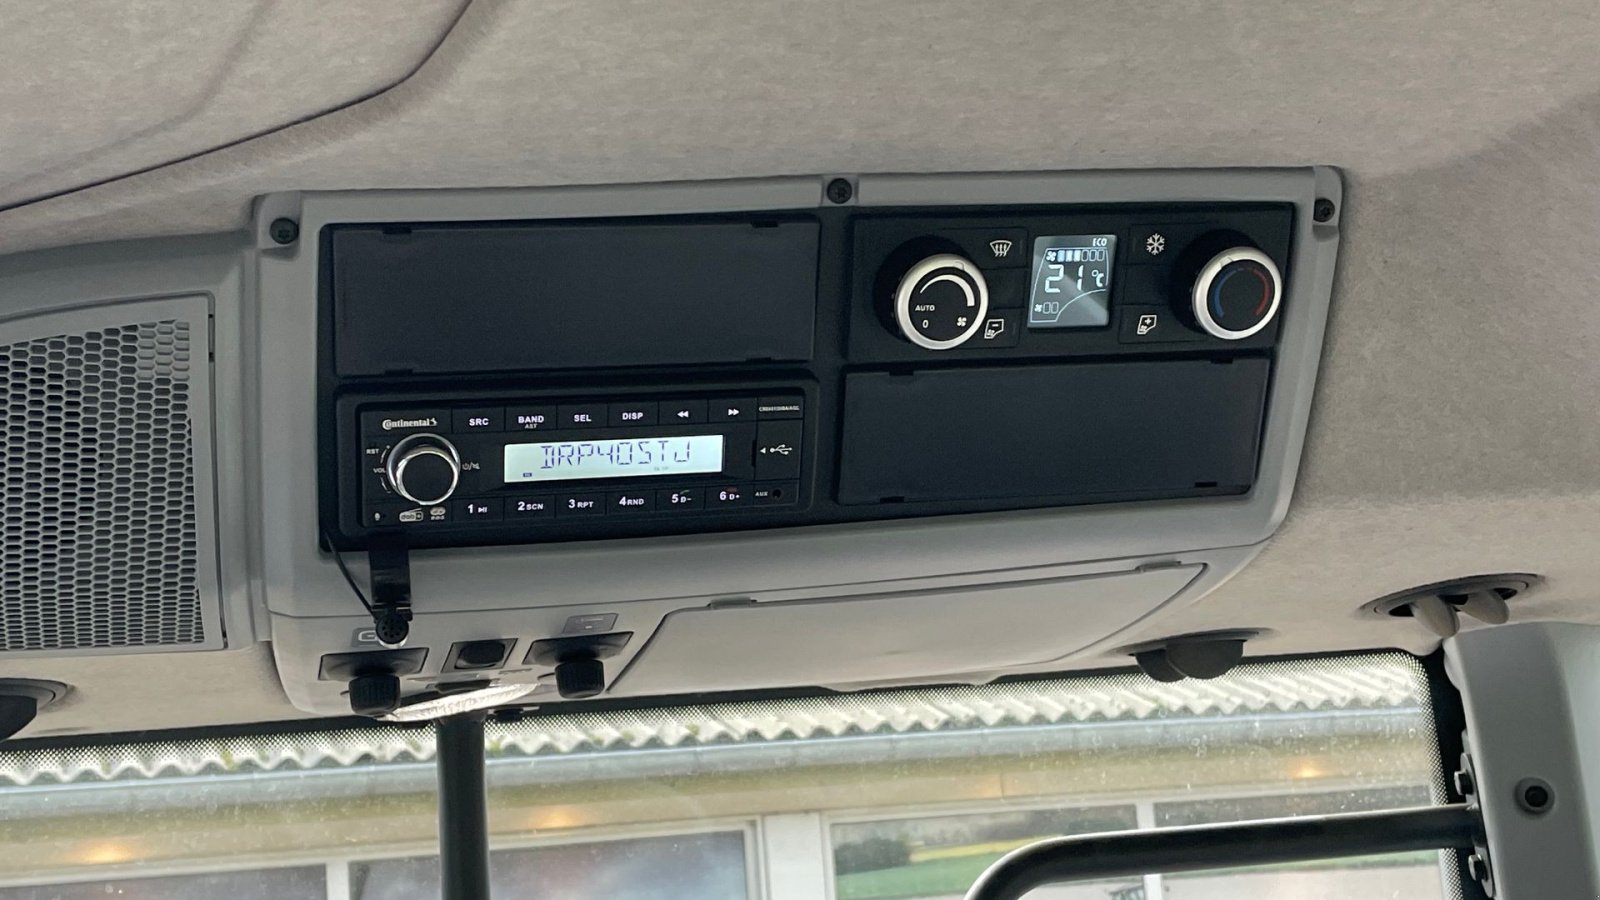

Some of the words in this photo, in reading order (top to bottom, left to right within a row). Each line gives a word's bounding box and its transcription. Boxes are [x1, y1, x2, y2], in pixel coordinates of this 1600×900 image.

[1092, 237, 1108, 247] ECO
[1045, 264, 1084, 293] 21
[915, 304, 935, 312] AUTO
[518, 415, 544, 424] BAND
[574, 414, 592, 422] SEL
[622, 412, 643, 420] DISP
[382, 418, 431, 430] Continental
[469, 417, 489, 426] SRC
[468, 504, 474, 513] 1
[577, 501, 594, 509] RPT
